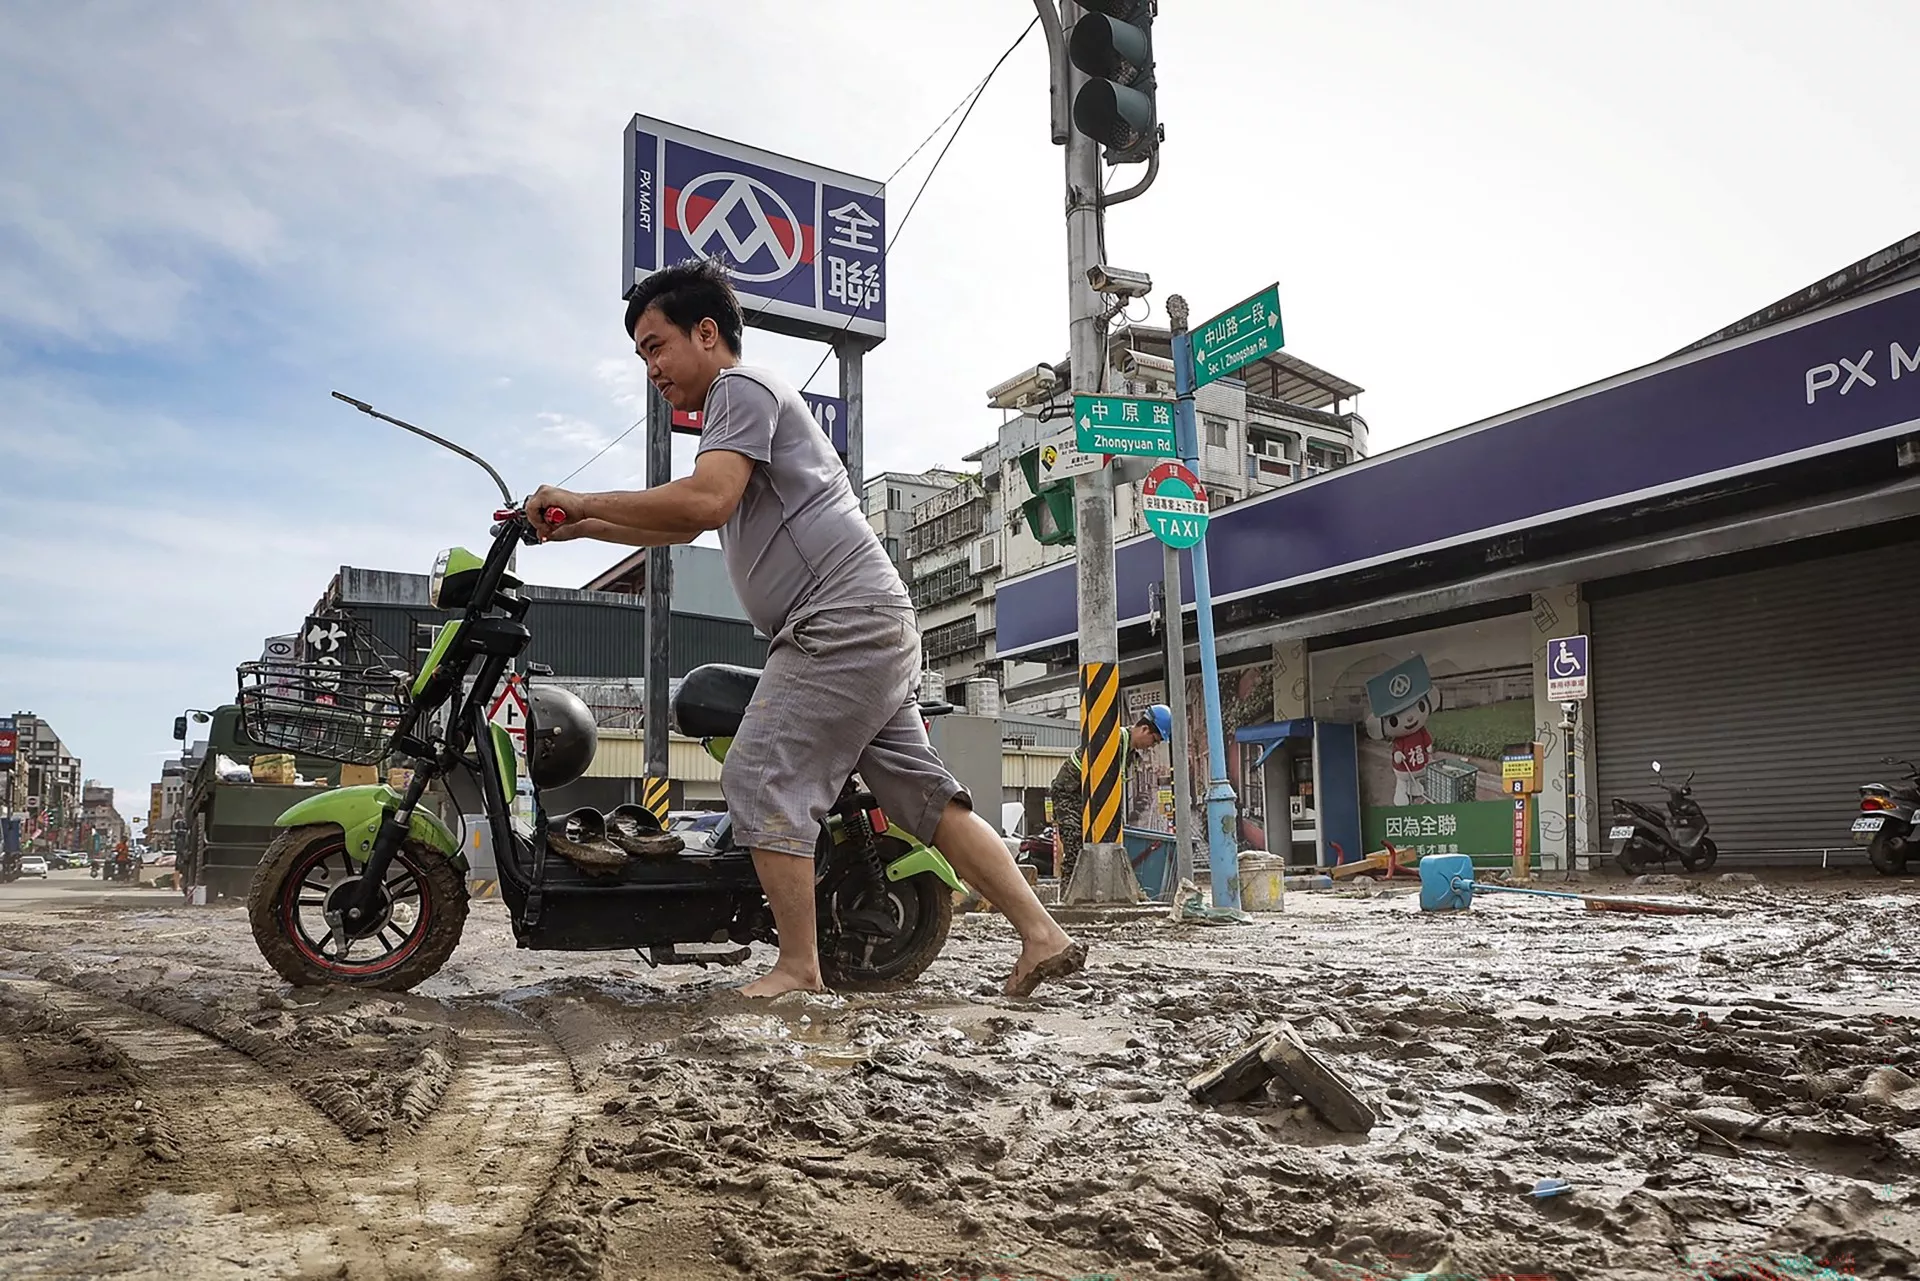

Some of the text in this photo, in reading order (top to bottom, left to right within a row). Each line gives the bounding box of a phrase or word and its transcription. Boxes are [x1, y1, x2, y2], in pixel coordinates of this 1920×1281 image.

[640, 169, 651, 232] PX MART
[827, 201, 880, 310] 全聯
[1204, 302, 1265, 349] 中山路一段
[1225, 343, 1258, 367] Zhongshan
[1805, 349, 1877, 405] PX
[1092, 400, 1170, 425] 中原路
[1094, 434, 1154, 452] Zhongyuan
[1157, 517, 1199, 538] TAXI
[1130, 691, 1161, 706] COFFEE
[1408, 745, 1425, 767] 福
[1514, 782, 1521, 792] 8
[1386, 814, 1457, 837] 因為全聯
